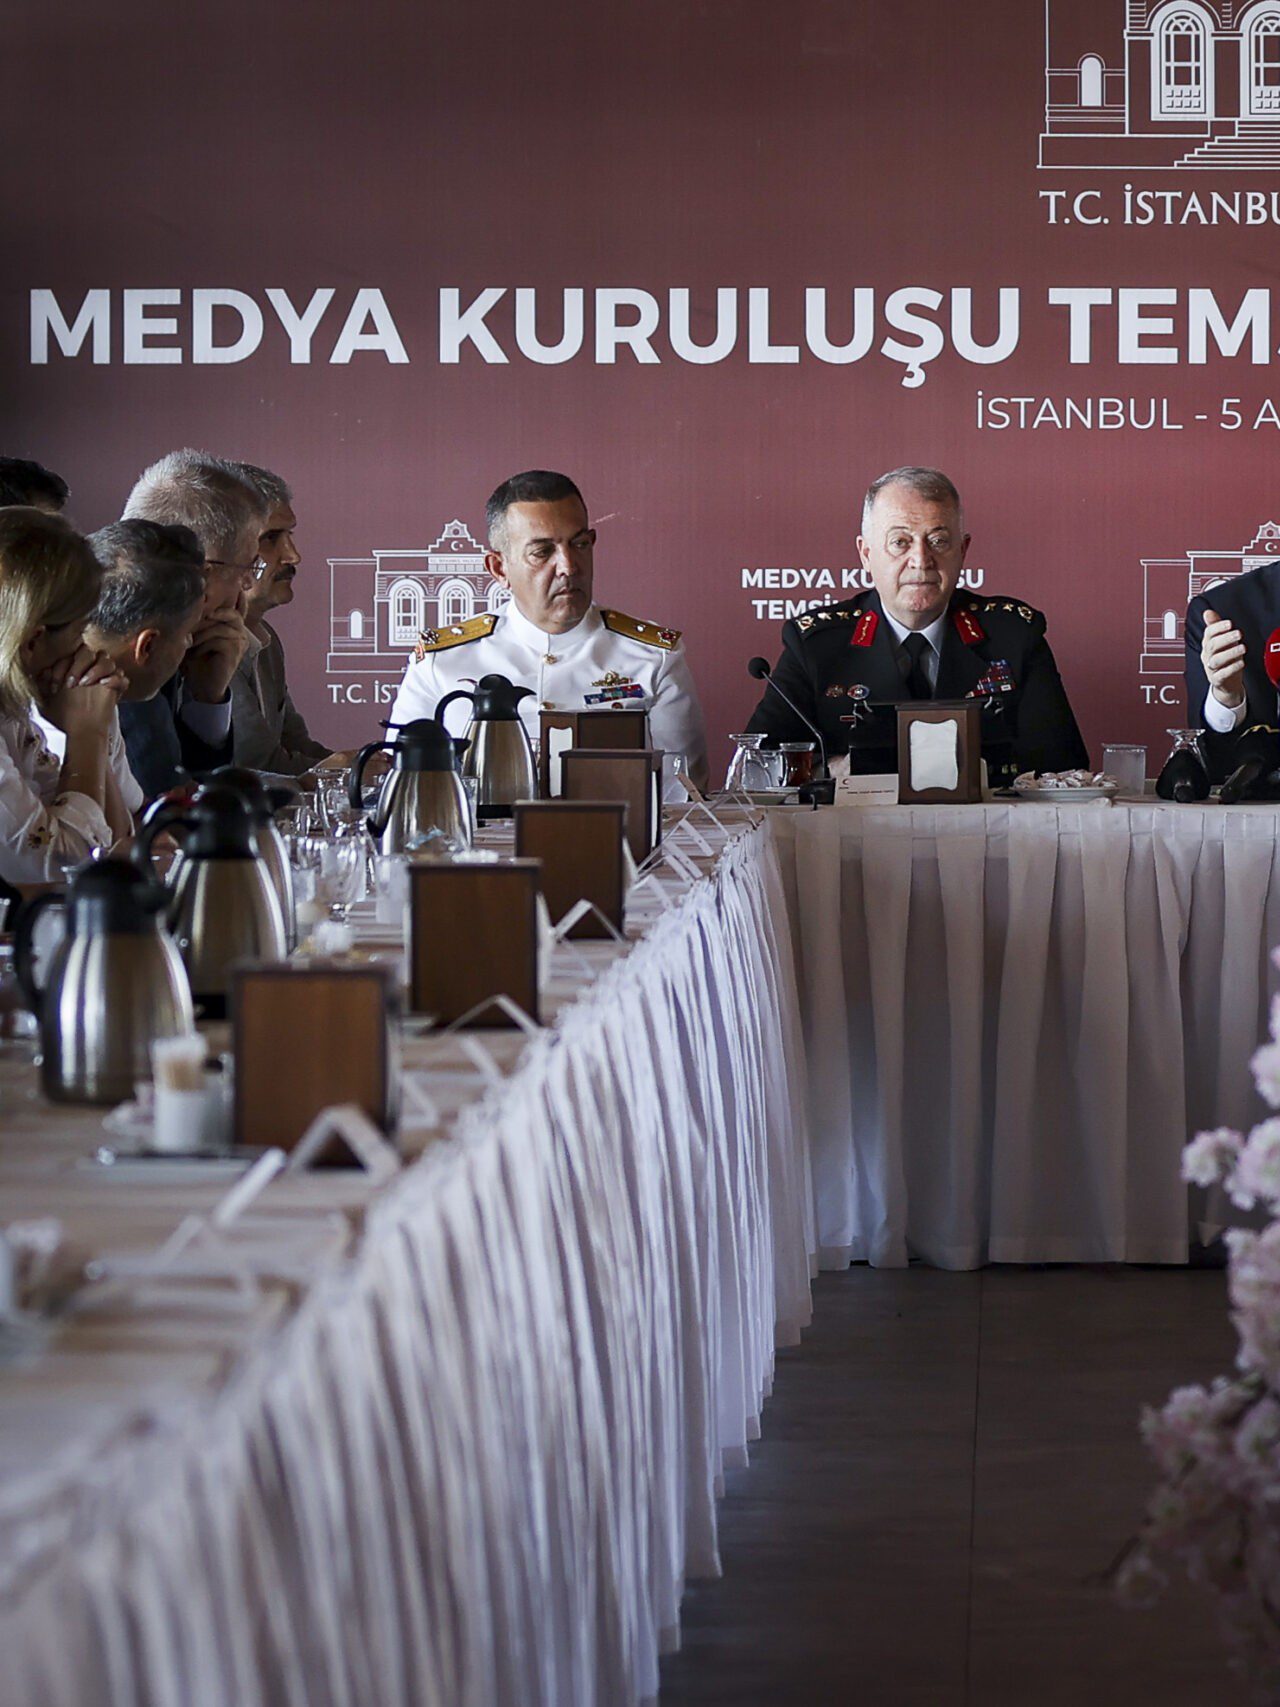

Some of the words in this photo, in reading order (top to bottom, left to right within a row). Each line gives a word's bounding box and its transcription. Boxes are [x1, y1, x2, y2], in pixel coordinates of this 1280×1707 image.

[1038, 190, 1110, 225] T.C.
[31, 288, 410, 364] MEDYA
[439, 287, 1021, 388] KURULUŞU
[976, 390, 1184, 430] İSTANBUL
[1219, 398, 1242, 430] 5
[741, 568, 836, 589] MEDYA
[326, 683, 367, 704] T.C.
[1140, 685, 1180, 705] T.C.
